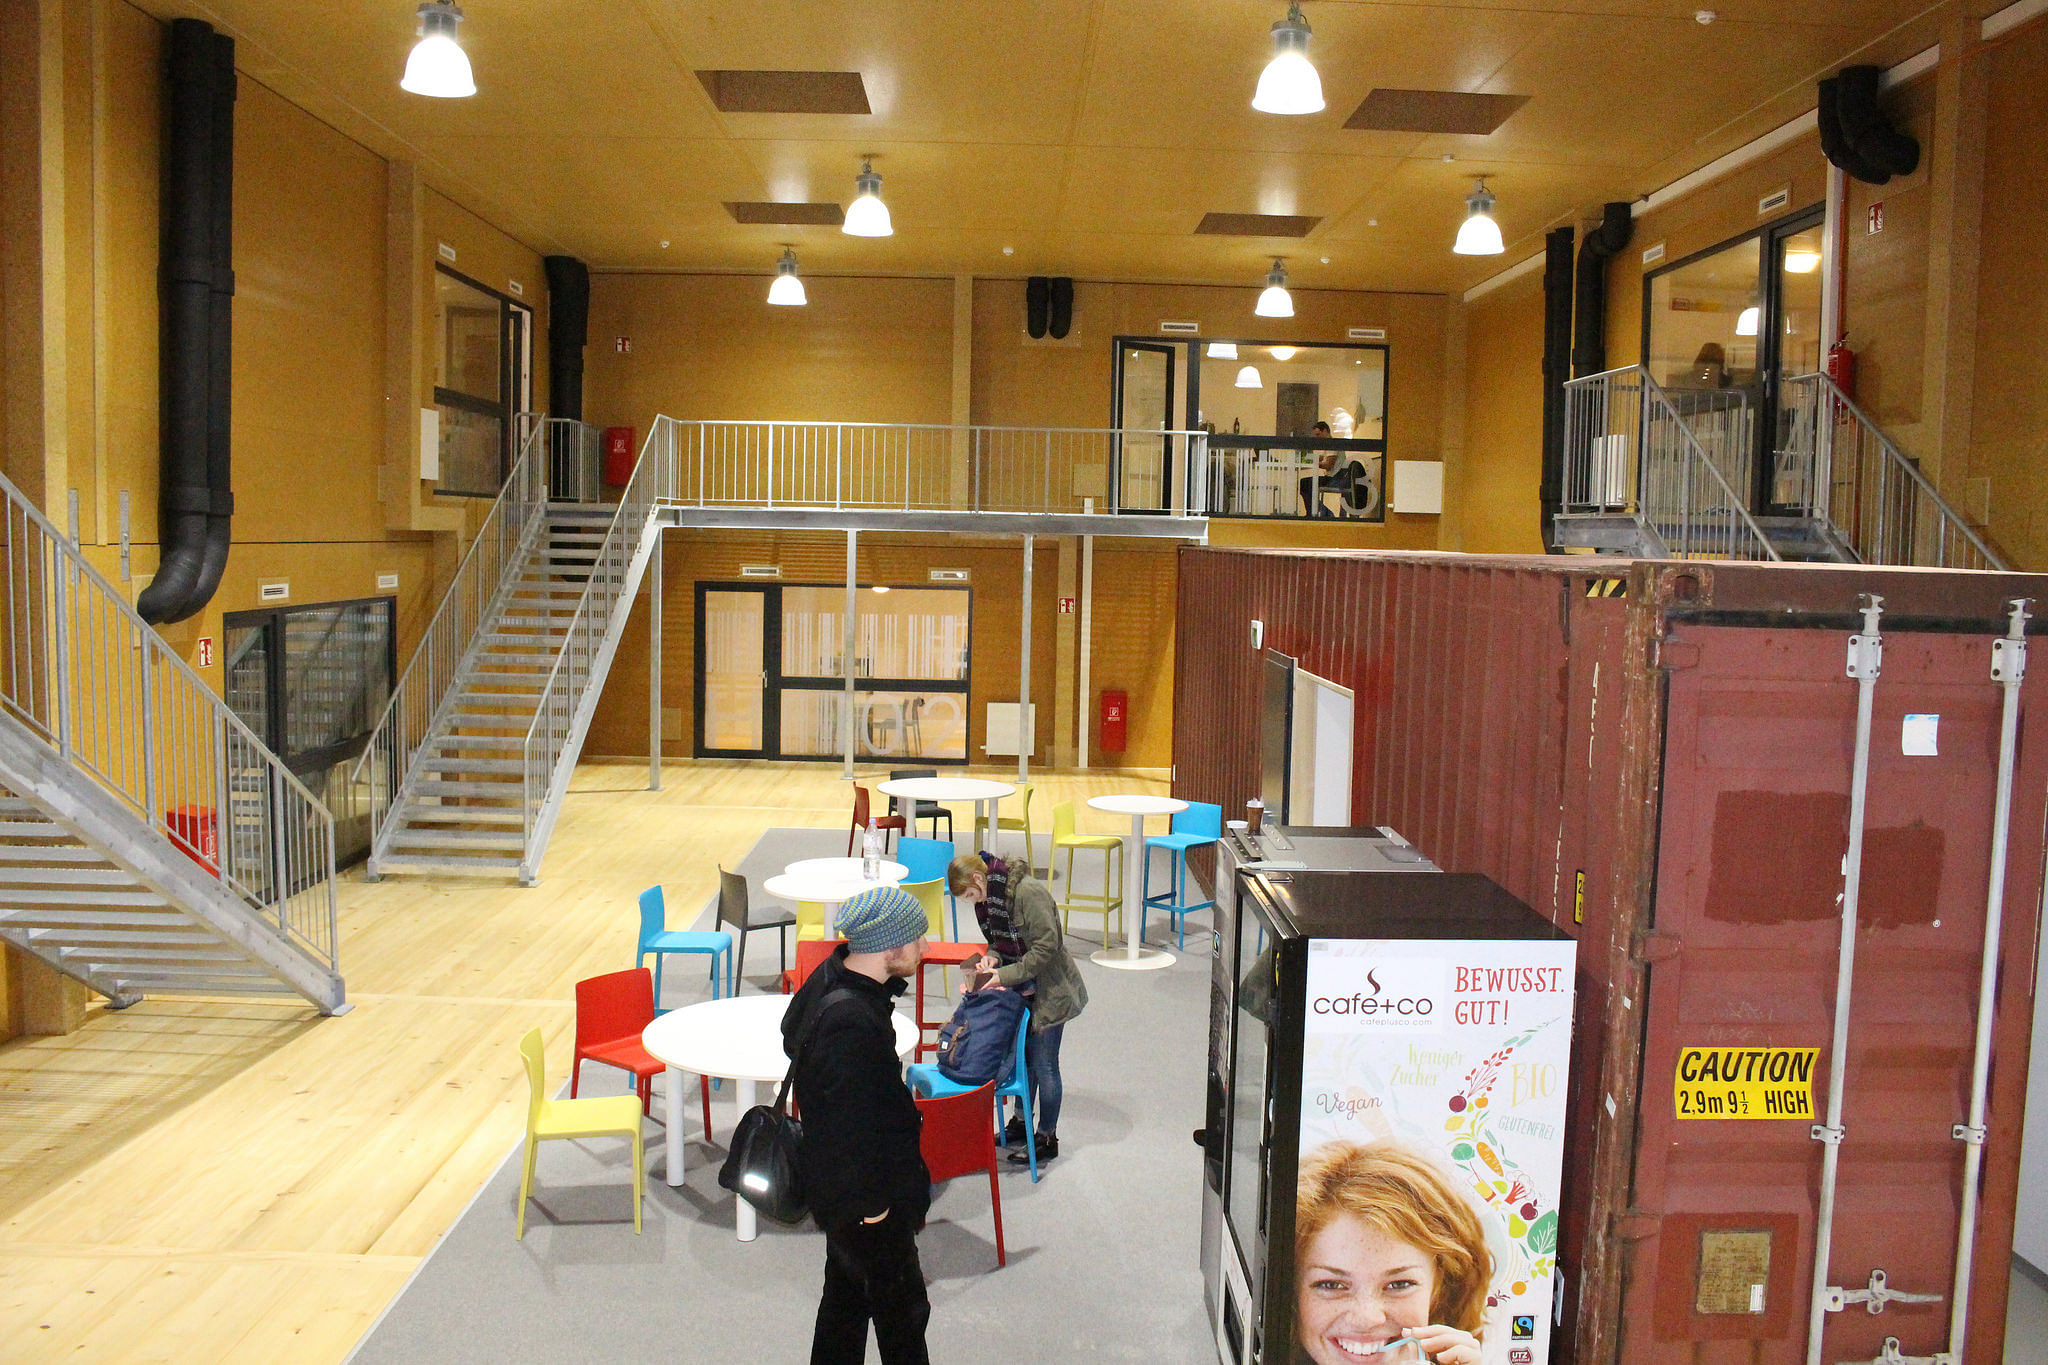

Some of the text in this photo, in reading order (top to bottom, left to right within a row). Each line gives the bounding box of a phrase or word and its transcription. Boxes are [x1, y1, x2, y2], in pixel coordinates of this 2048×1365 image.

[1454, 967, 1565, 993] BEWUSST.
[1360, 1018, 1433, 1027] cafeplusco.com
[1454, 1000, 1509, 1026] GUT!
[1681, 1051, 1814, 1083] CAUTION
[1511, 1063, 1557, 1107] BIO
[1316, 1092, 1382, 1120] Vegan
[1764, 1090, 1809, 1114] HIGH
[1498, 1115, 1555, 1141] GLUTENFREI
[1512, 1351, 1528, 1359] UTZ
